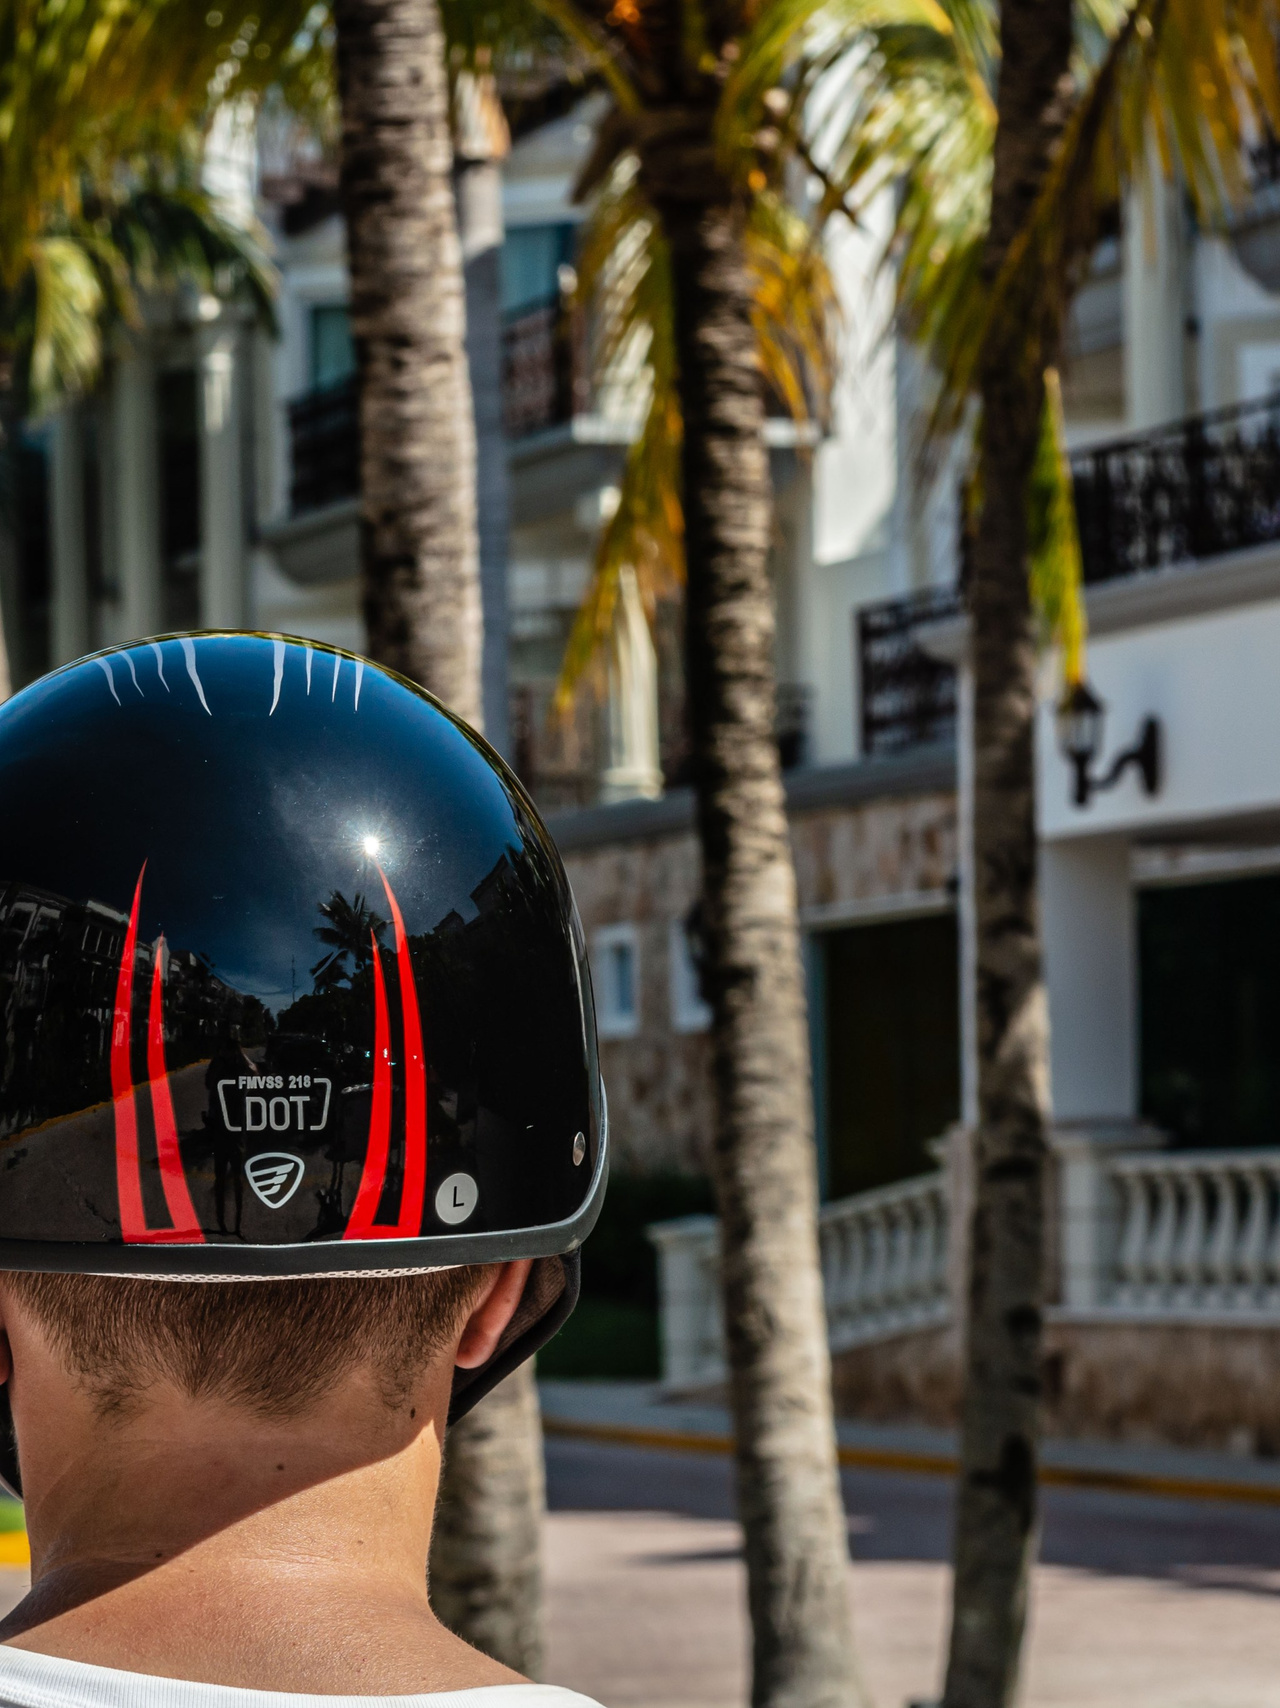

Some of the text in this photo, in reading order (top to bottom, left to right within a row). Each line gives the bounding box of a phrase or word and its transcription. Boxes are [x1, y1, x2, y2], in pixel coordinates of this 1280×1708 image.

[238, 1075, 311, 1089] FMVSS 218
[246, 1096, 310, 1131] DOT
[453, 1186, 465, 1208] L
